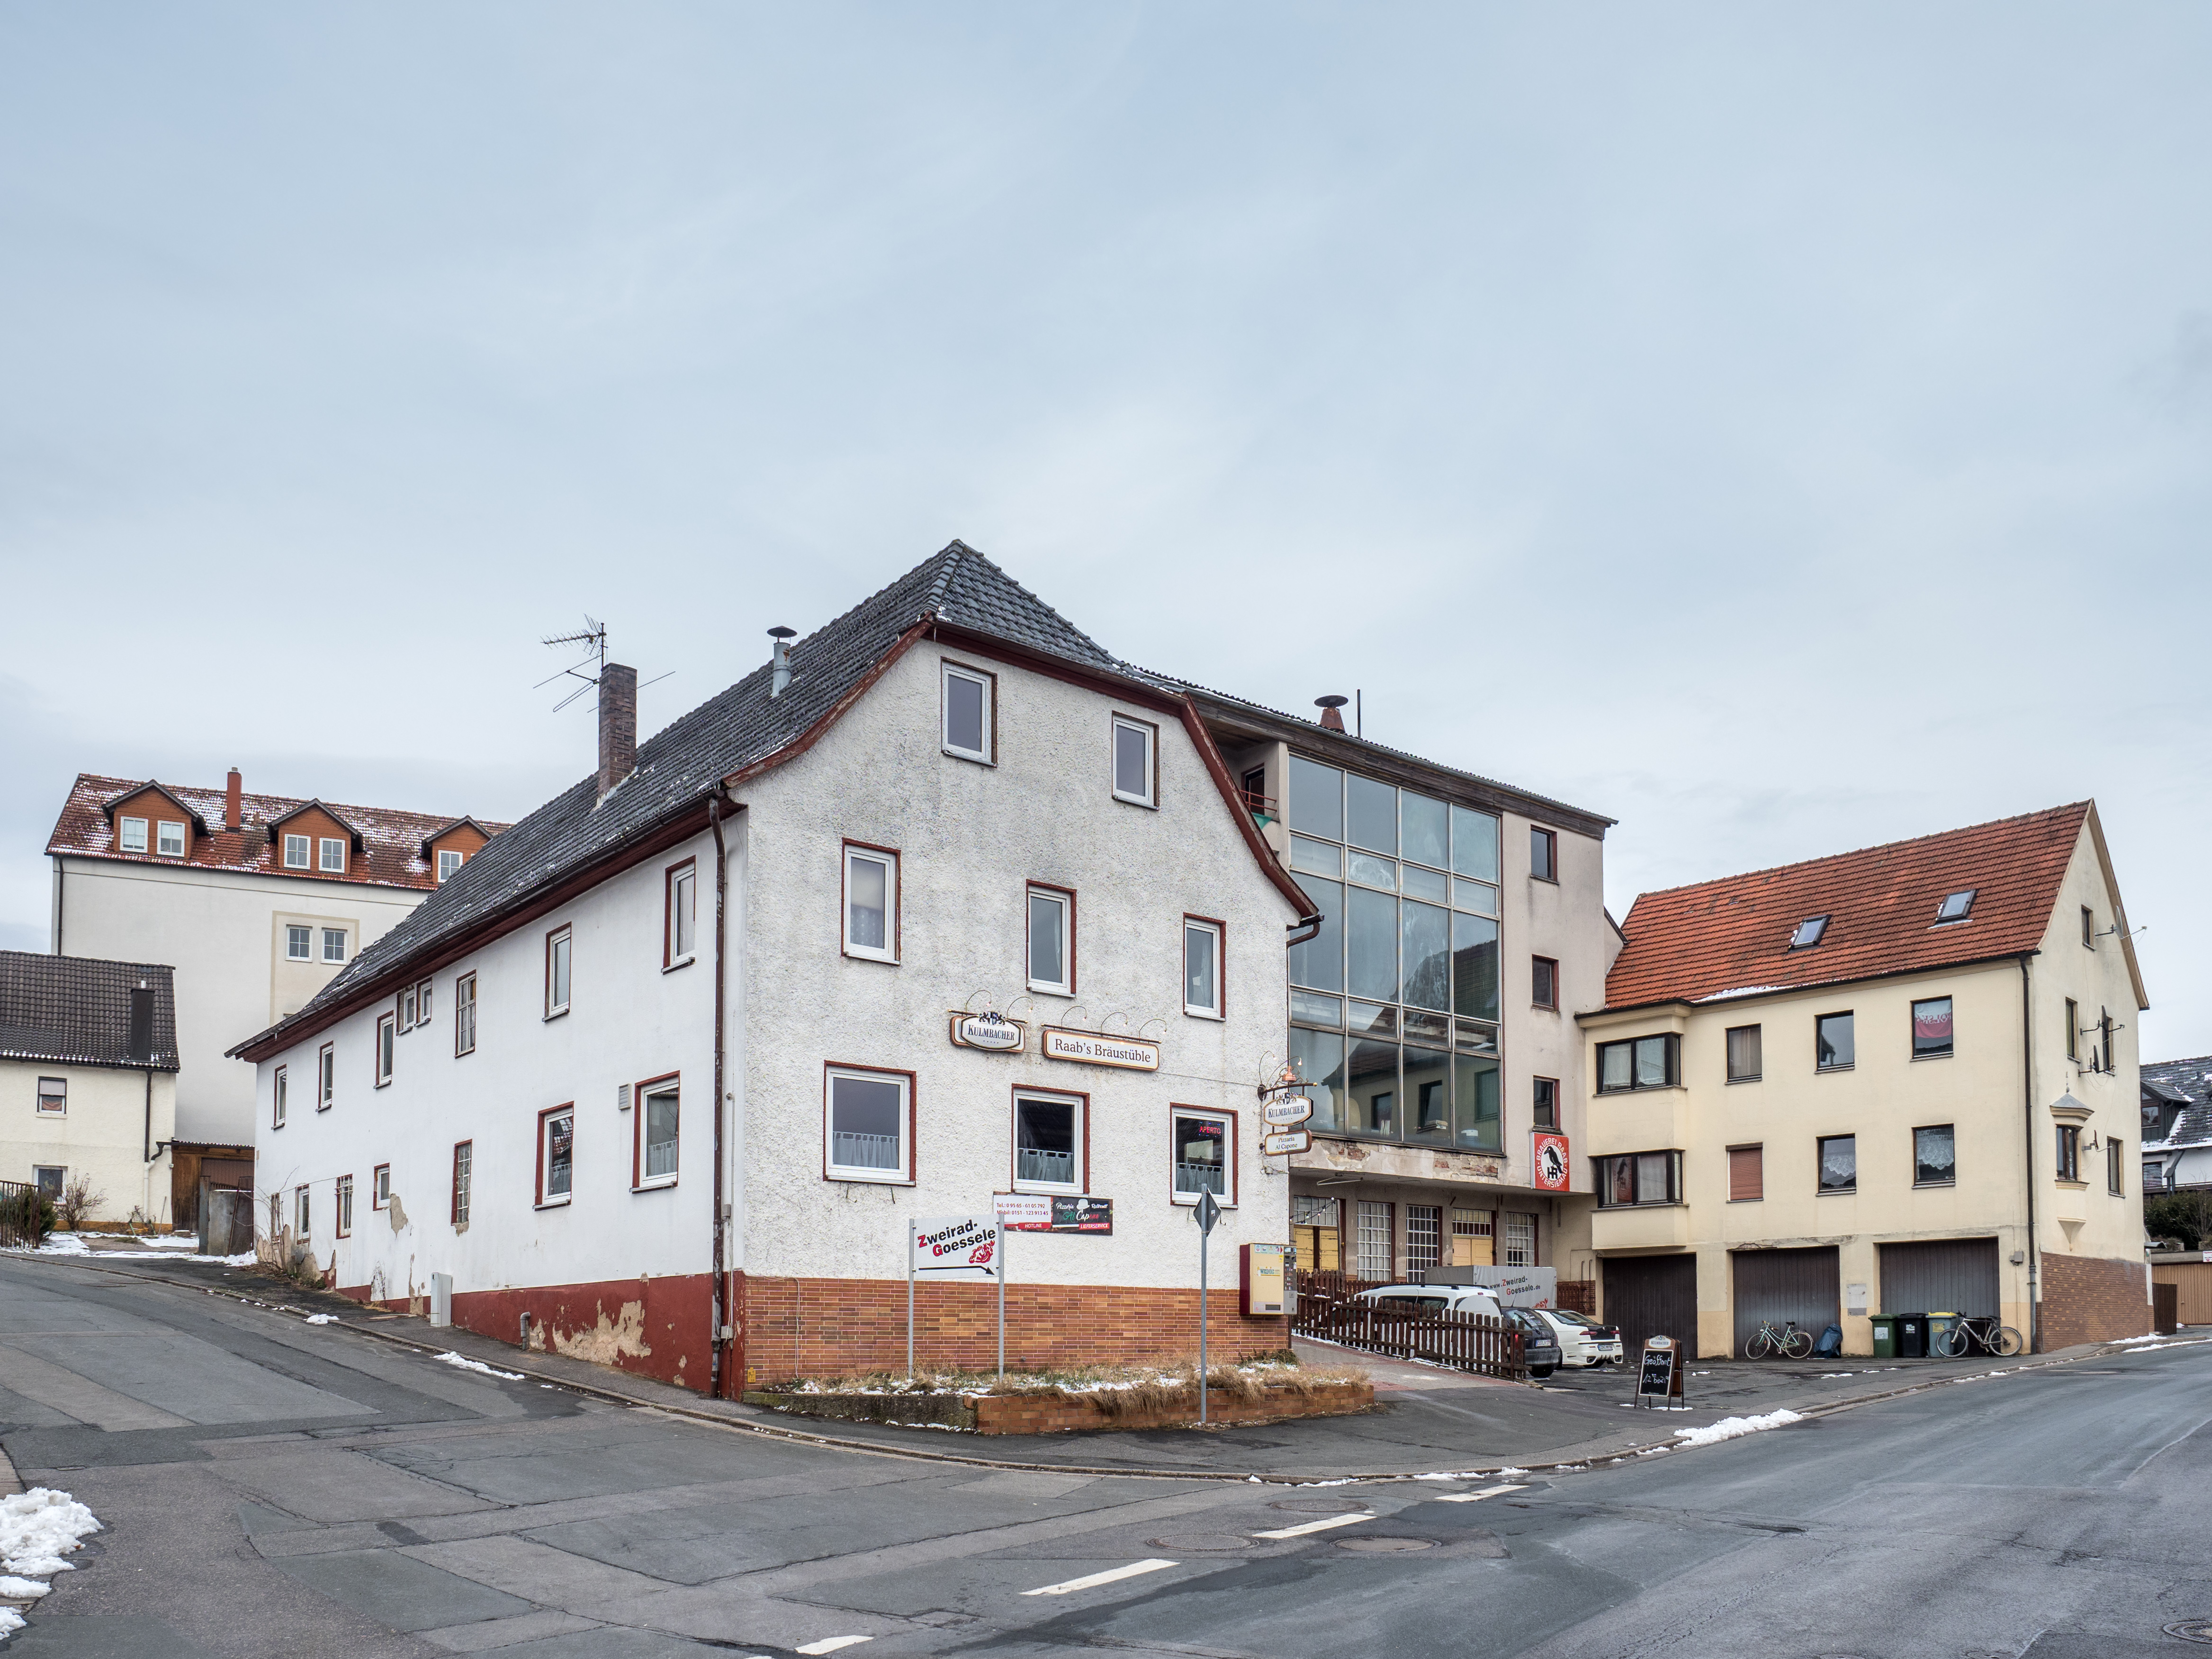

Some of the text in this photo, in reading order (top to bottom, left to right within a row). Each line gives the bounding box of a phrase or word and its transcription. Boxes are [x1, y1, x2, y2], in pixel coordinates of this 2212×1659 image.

[968, 1024, 1015, 1040] KULMBACHER
[1055, 1039, 1151, 1062] Raab's Bräustüble
[1268, 1105, 1305, 1118] KULMBACHER
[1199, 1126, 1222, 1134] APERTO
[1281, 1143, 1298, 1151] Capone
[1536, 1138, 1557, 1160] BRAUEREI
[1557, 1142, 1568, 1164] RAAB
[1537, 1166, 1568, 1188] UNTERSIEMAU
[917, 1219, 978, 1248] Zweirad-
[933, 1229, 996, 1257] Goessele
[1489, 1275, 1528, 1290] www.Zweirad-
[1506, 1284, 1540, 1295] Goessele.de
[1644, 1354, 1671, 1366] Geöffnet
